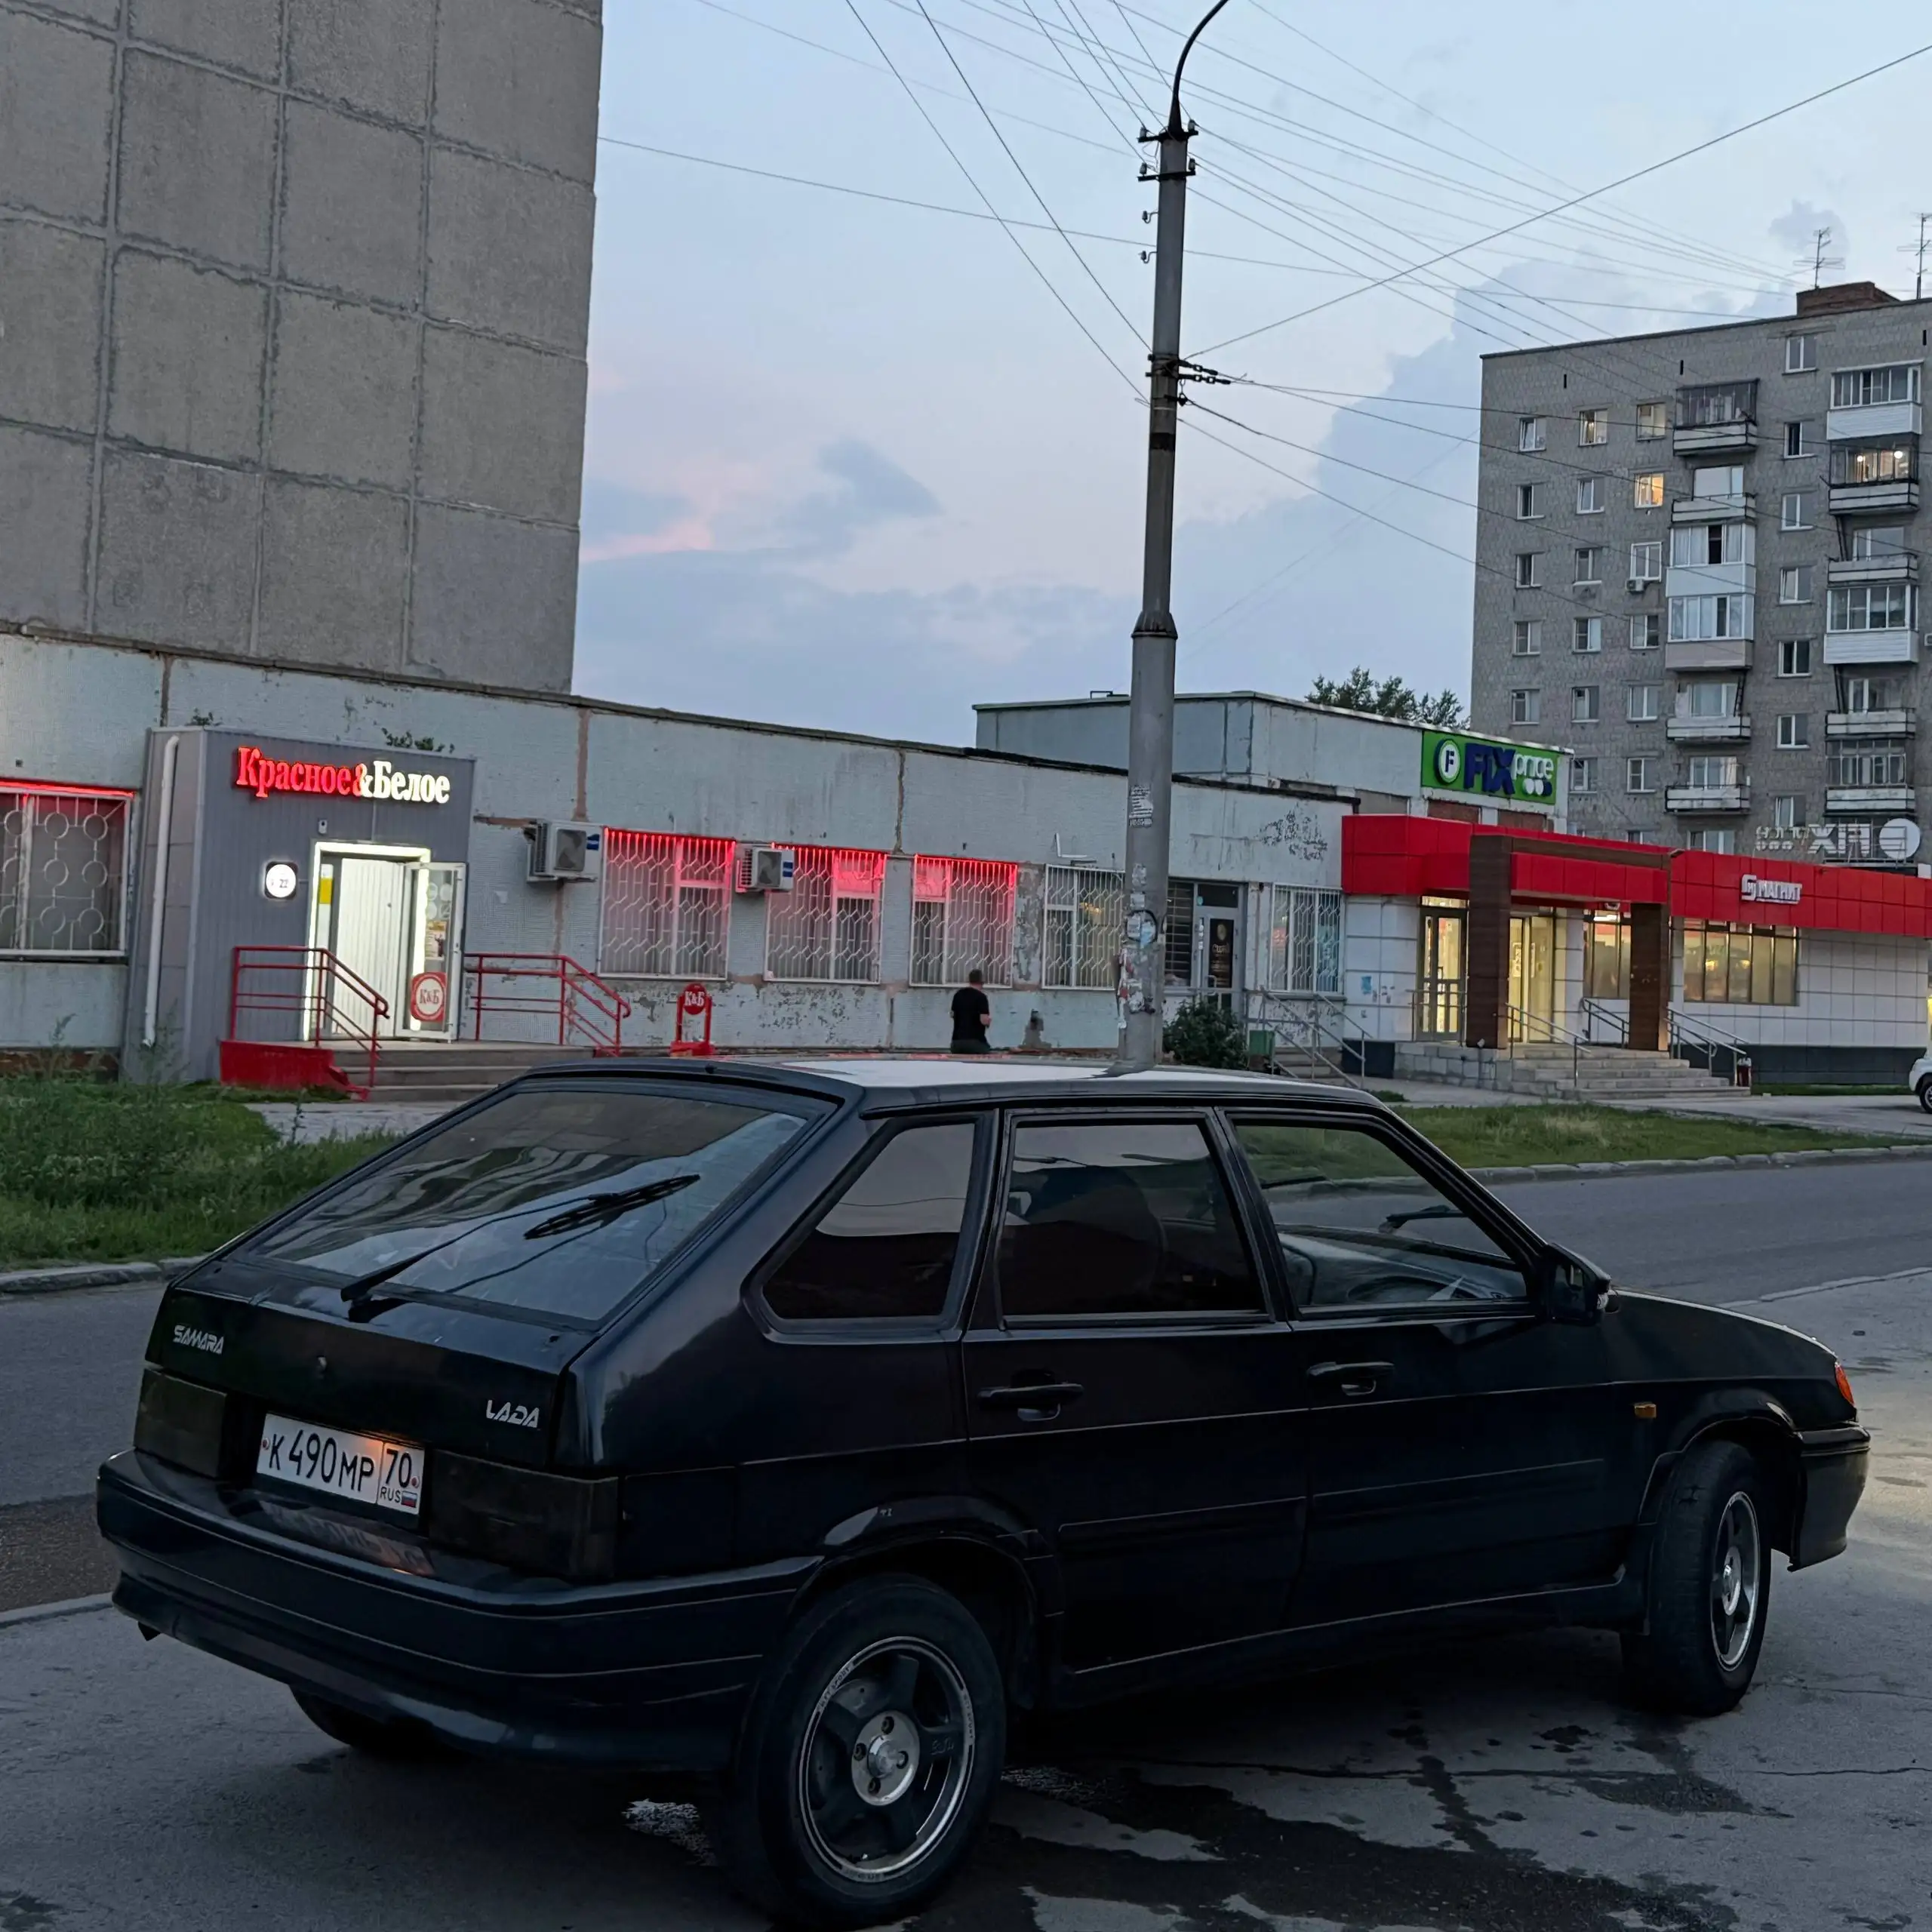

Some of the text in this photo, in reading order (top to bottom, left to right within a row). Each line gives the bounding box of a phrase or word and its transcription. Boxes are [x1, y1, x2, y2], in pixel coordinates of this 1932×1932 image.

[1463, 743, 1555, 795] FIX price
[419, 988, 440, 1005] К&Б
[685, 990, 706, 1007] К&Б
[174, 1324, 225, 1356] SAMARA
[486, 1398, 540, 1429] LADA
[386, 1448, 412, 1489] 70
[380, 1484, 401, 1503] RUS
